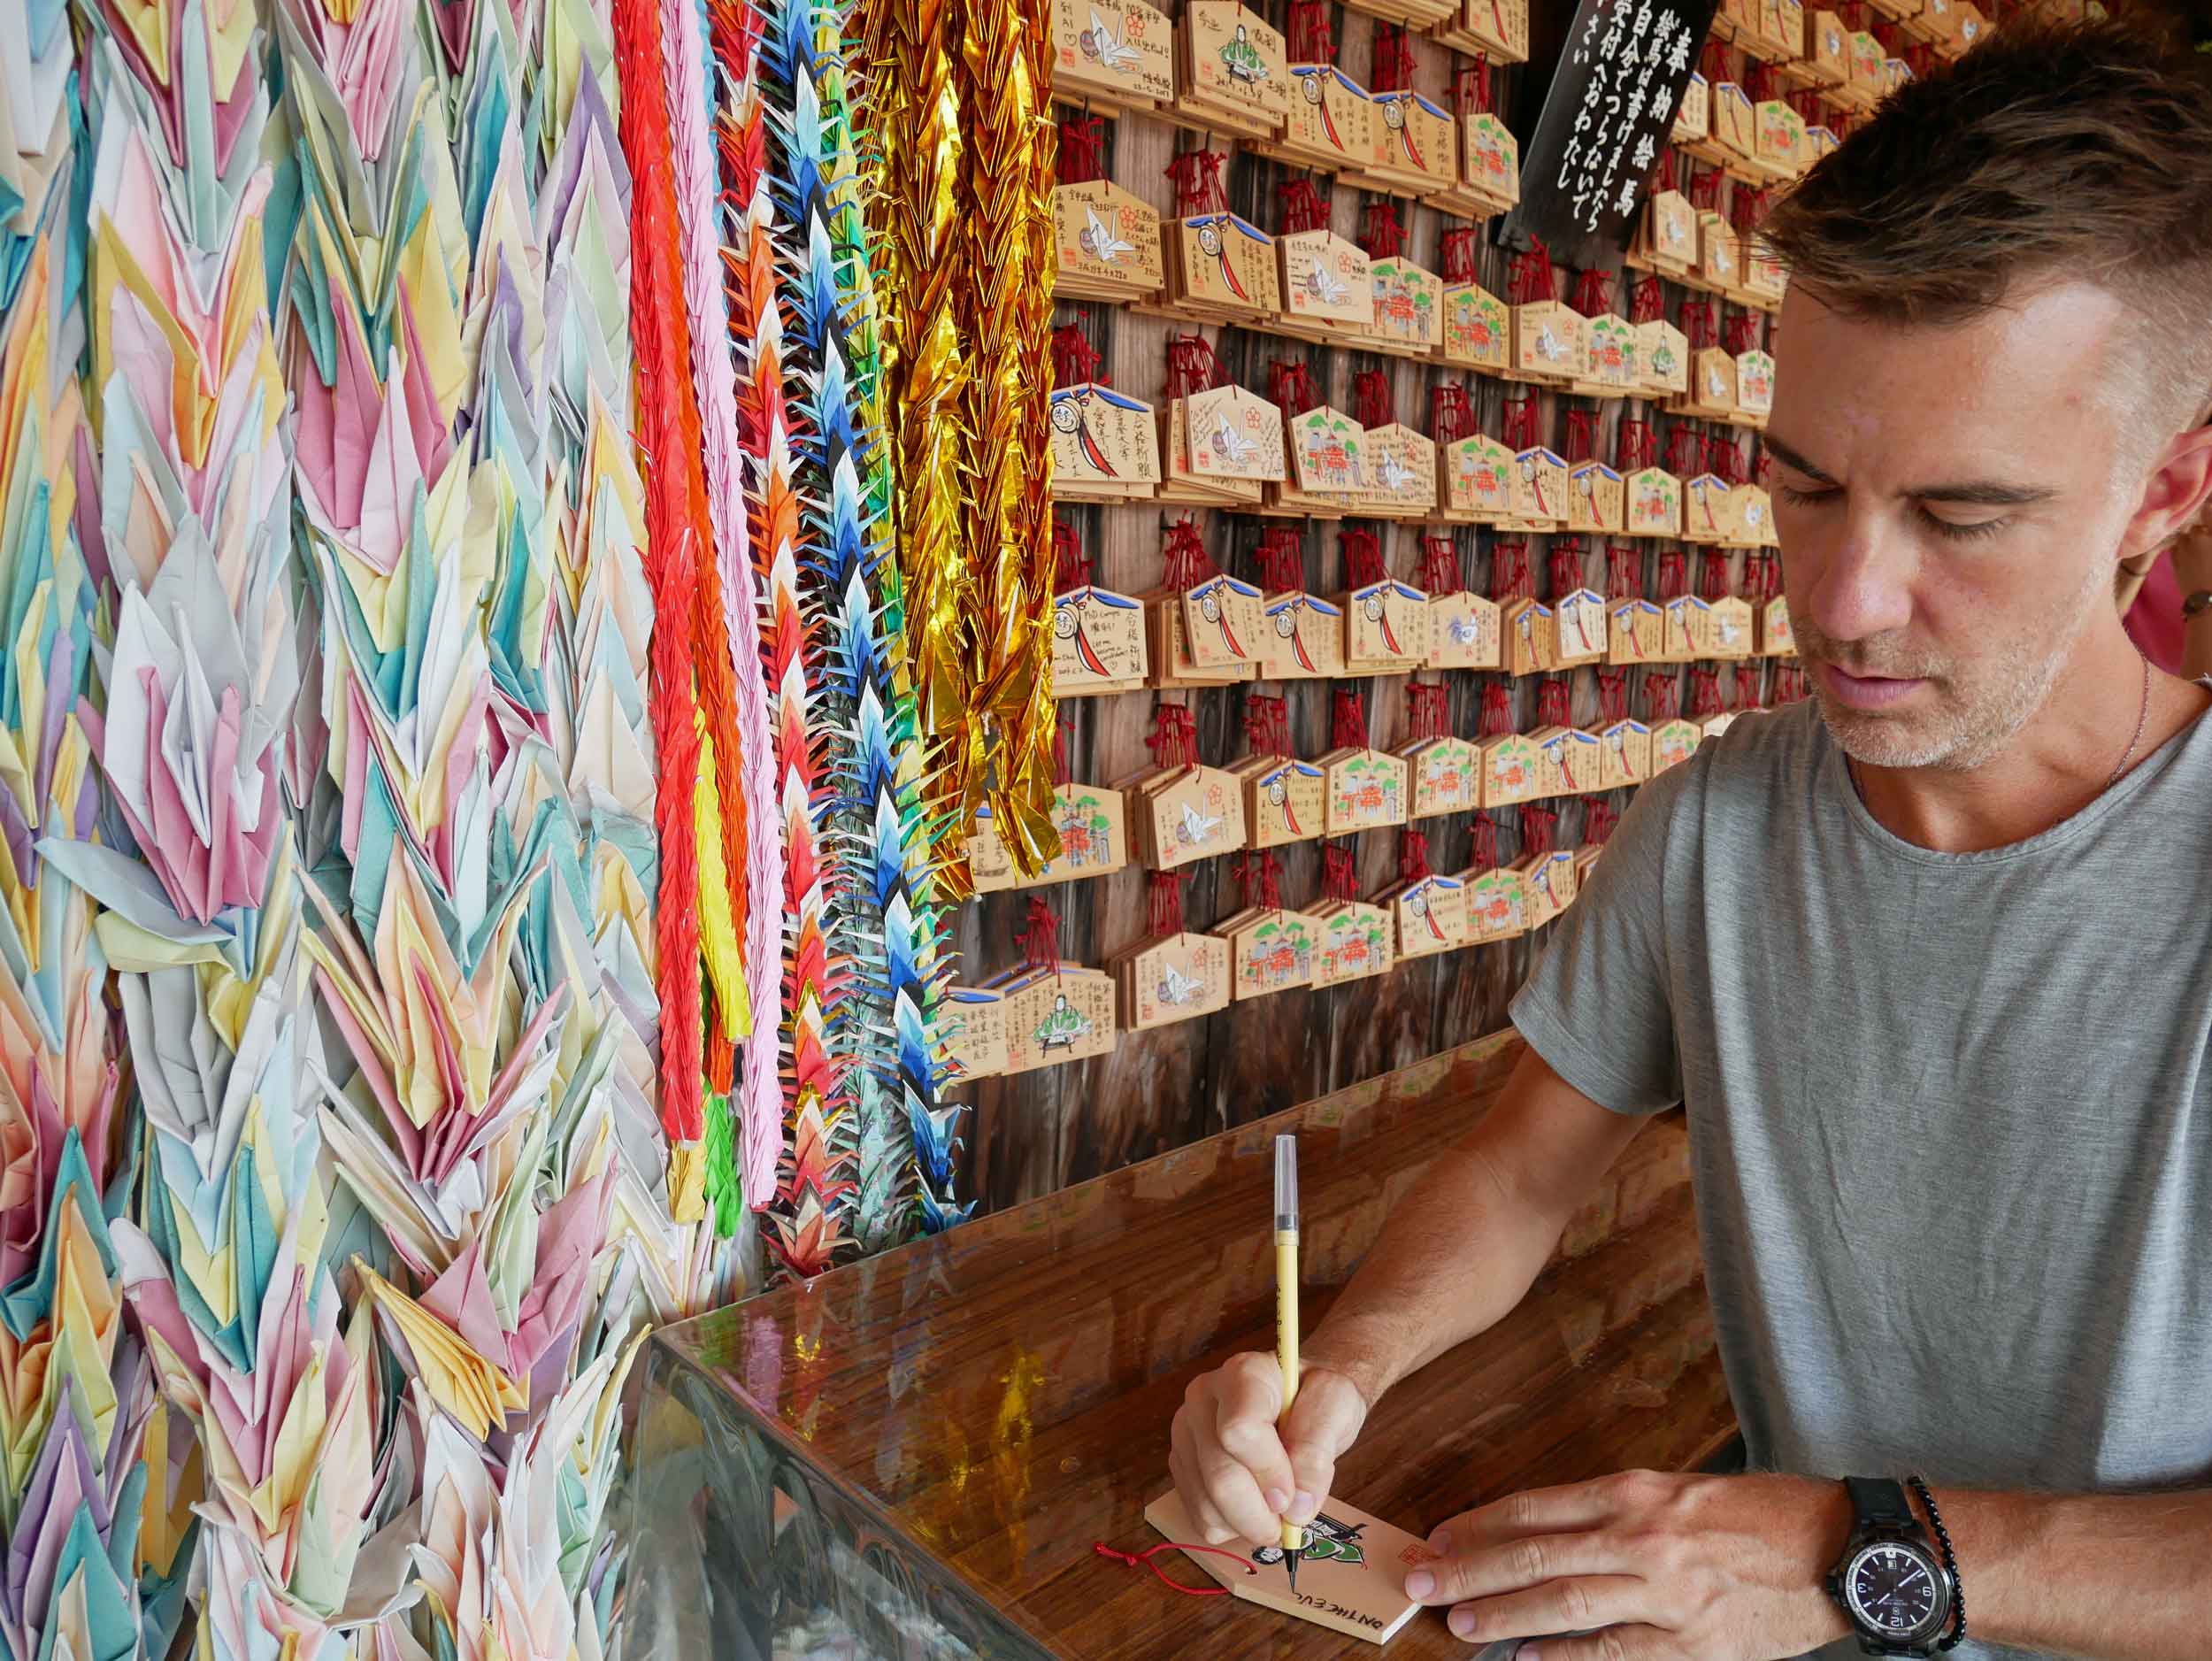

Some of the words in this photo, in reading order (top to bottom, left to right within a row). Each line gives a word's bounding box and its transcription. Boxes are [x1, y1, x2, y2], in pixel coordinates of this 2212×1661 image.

[1613, 27, 1693, 219] 奉納絵馬
[1857, 1583, 1867, 1594] 3
[1357, 1613, 1384, 1629] ON
[1891, 1617, 1903, 1626] 12
